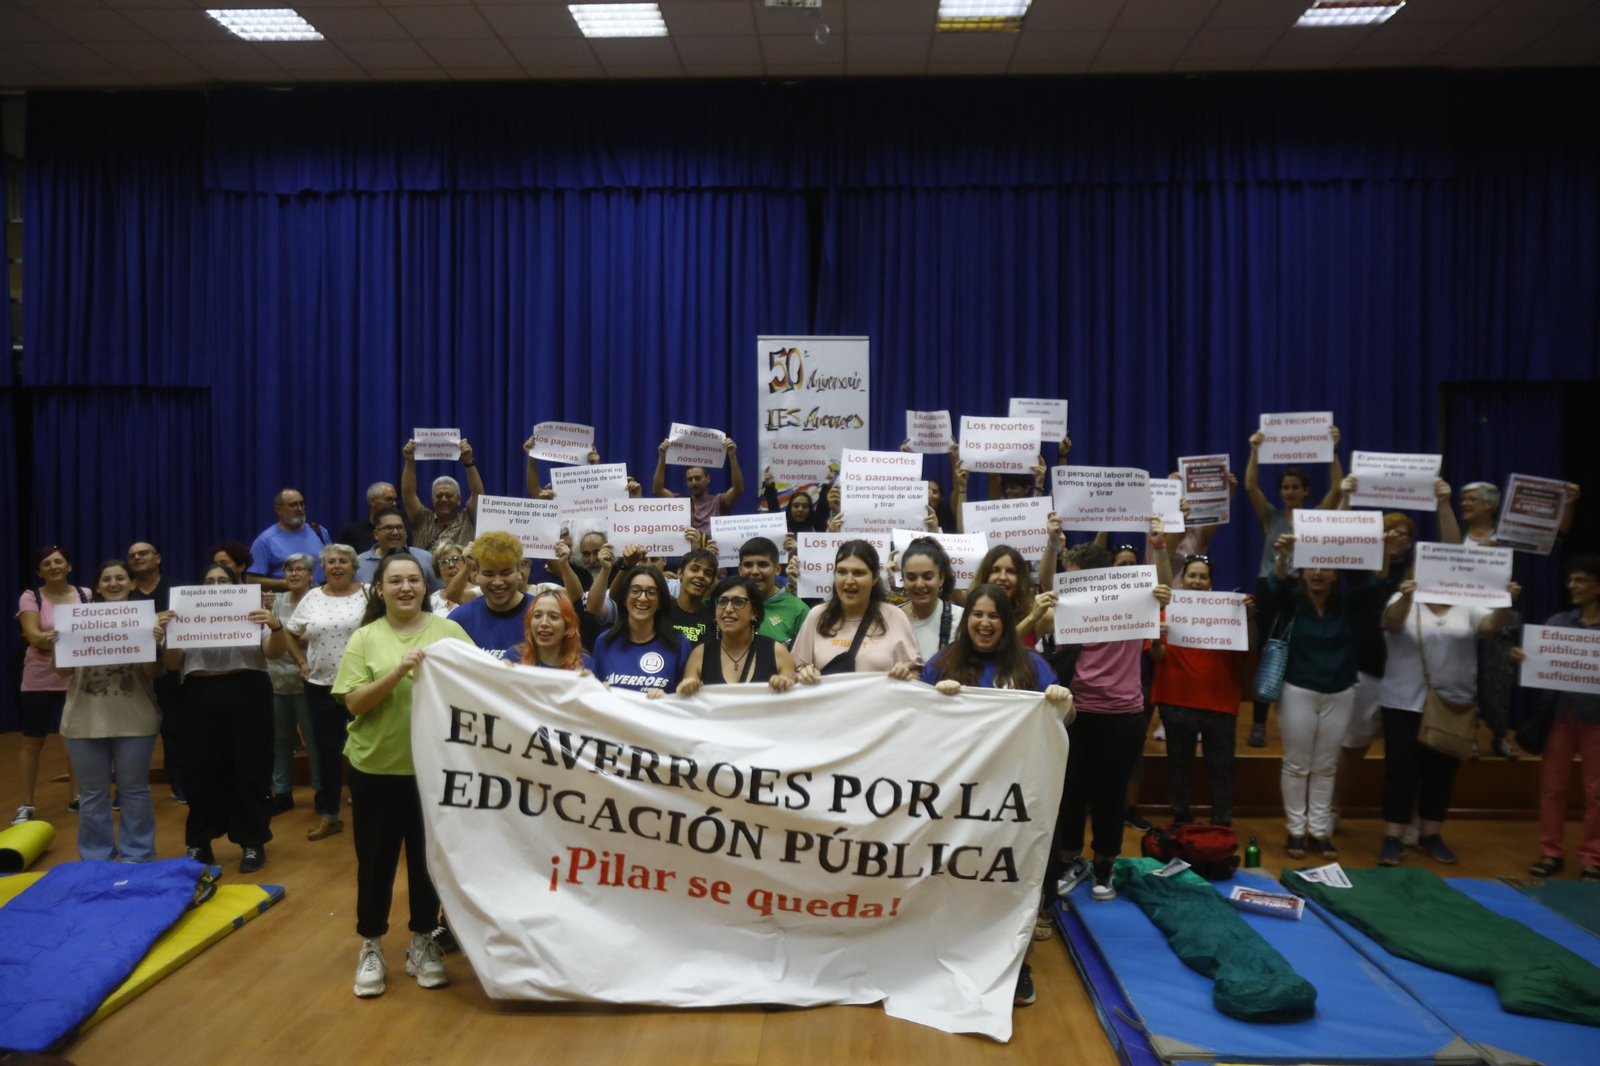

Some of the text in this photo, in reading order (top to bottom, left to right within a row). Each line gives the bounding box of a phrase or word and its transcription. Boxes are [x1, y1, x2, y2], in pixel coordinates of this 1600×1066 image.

[765, 408, 801, 431] IES
[1285, 416, 1327, 425] recortes
[556, 425, 590, 435] recortes
[966, 421, 1035, 431] Los recortes
[675, 427, 723, 440] Los recortes
[535, 435, 589, 449] los pagamos
[1281, 434, 1328, 444] pagamos
[685, 443, 723, 453] pagamos
[791, 442, 826, 450] recortes
[965, 440, 1035, 452] los pagamos
[542, 451, 579, 462] nosotras
[677, 455, 714, 465] nosotras
[848, 454, 916, 465] Los recortes
[1273, 451, 1318, 459] nosotras
[787, 458, 826, 466] pagamos
[975, 459, 1023, 469] nosotras
[846, 472, 861, 480] los
[1057, 470, 1066, 478] El
[1067, 470, 1102, 480] personal
[1104, 471, 1133, 479] laboral
[1058, 479, 1084, 487] somos
[1086, 480, 1113, 489] trapos
[1089, 490, 1095, 498] y
[491, 500, 522, 508] personal
[614, 503, 685, 512] Los recortes
[975, 504, 999, 512] Bajada
[507, 508, 530, 516] trapos
[1078, 506, 1105, 514] Vuelta
[990, 514, 1026, 523] alumnado
[1300, 514, 1376, 524] Los recortes
[613, 523, 685, 534] los pagamos
[989, 530, 1001, 539] de
[804, 538, 828, 548] Los
[1301, 534, 1378, 546] los pagamos
[803, 561, 822, 570] los
[1310, 556, 1364, 565] nosotras
[1059, 577, 1068, 585] El
[1069, 573, 1107, 585] personal
[1109, 571, 1139, 581] laboral
[1059, 581, 1153, 594] somos trapos de usar
[180, 589, 206, 597] Bajada
[1094, 593, 1119, 603] y tirar
[1173, 595, 1241, 606] Los recortes
[73, 606, 138, 618] Educación
[176, 615, 191, 624] No
[194, 614, 207, 623] de
[1082, 614, 1110, 623] Vuelta
[1112, 613, 1123, 621] de
[1171, 614, 1241, 627] los pagamos
[71, 619, 139, 632] pública sin
[1060, 621, 1155, 635] compañera trasladada
[83, 632, 129, 643] medios
[177, 631, 253, 642] administrativo
[1182, 635, 1232, 645] nosotras
[72, 645, 140, 657] suficientes
[1540, 645, 1588, 656] pública
[1550, 660, 1599, 671] medios
[608, 672, 669, 687] AVERROES
[445, 705, 1032, 822] EL AVERROES POR LA
[438, 769, 1020, 882] EDUCACIÓN PÚBLICA
[550, 846, 902, 918] ¡Pilar se queda!
